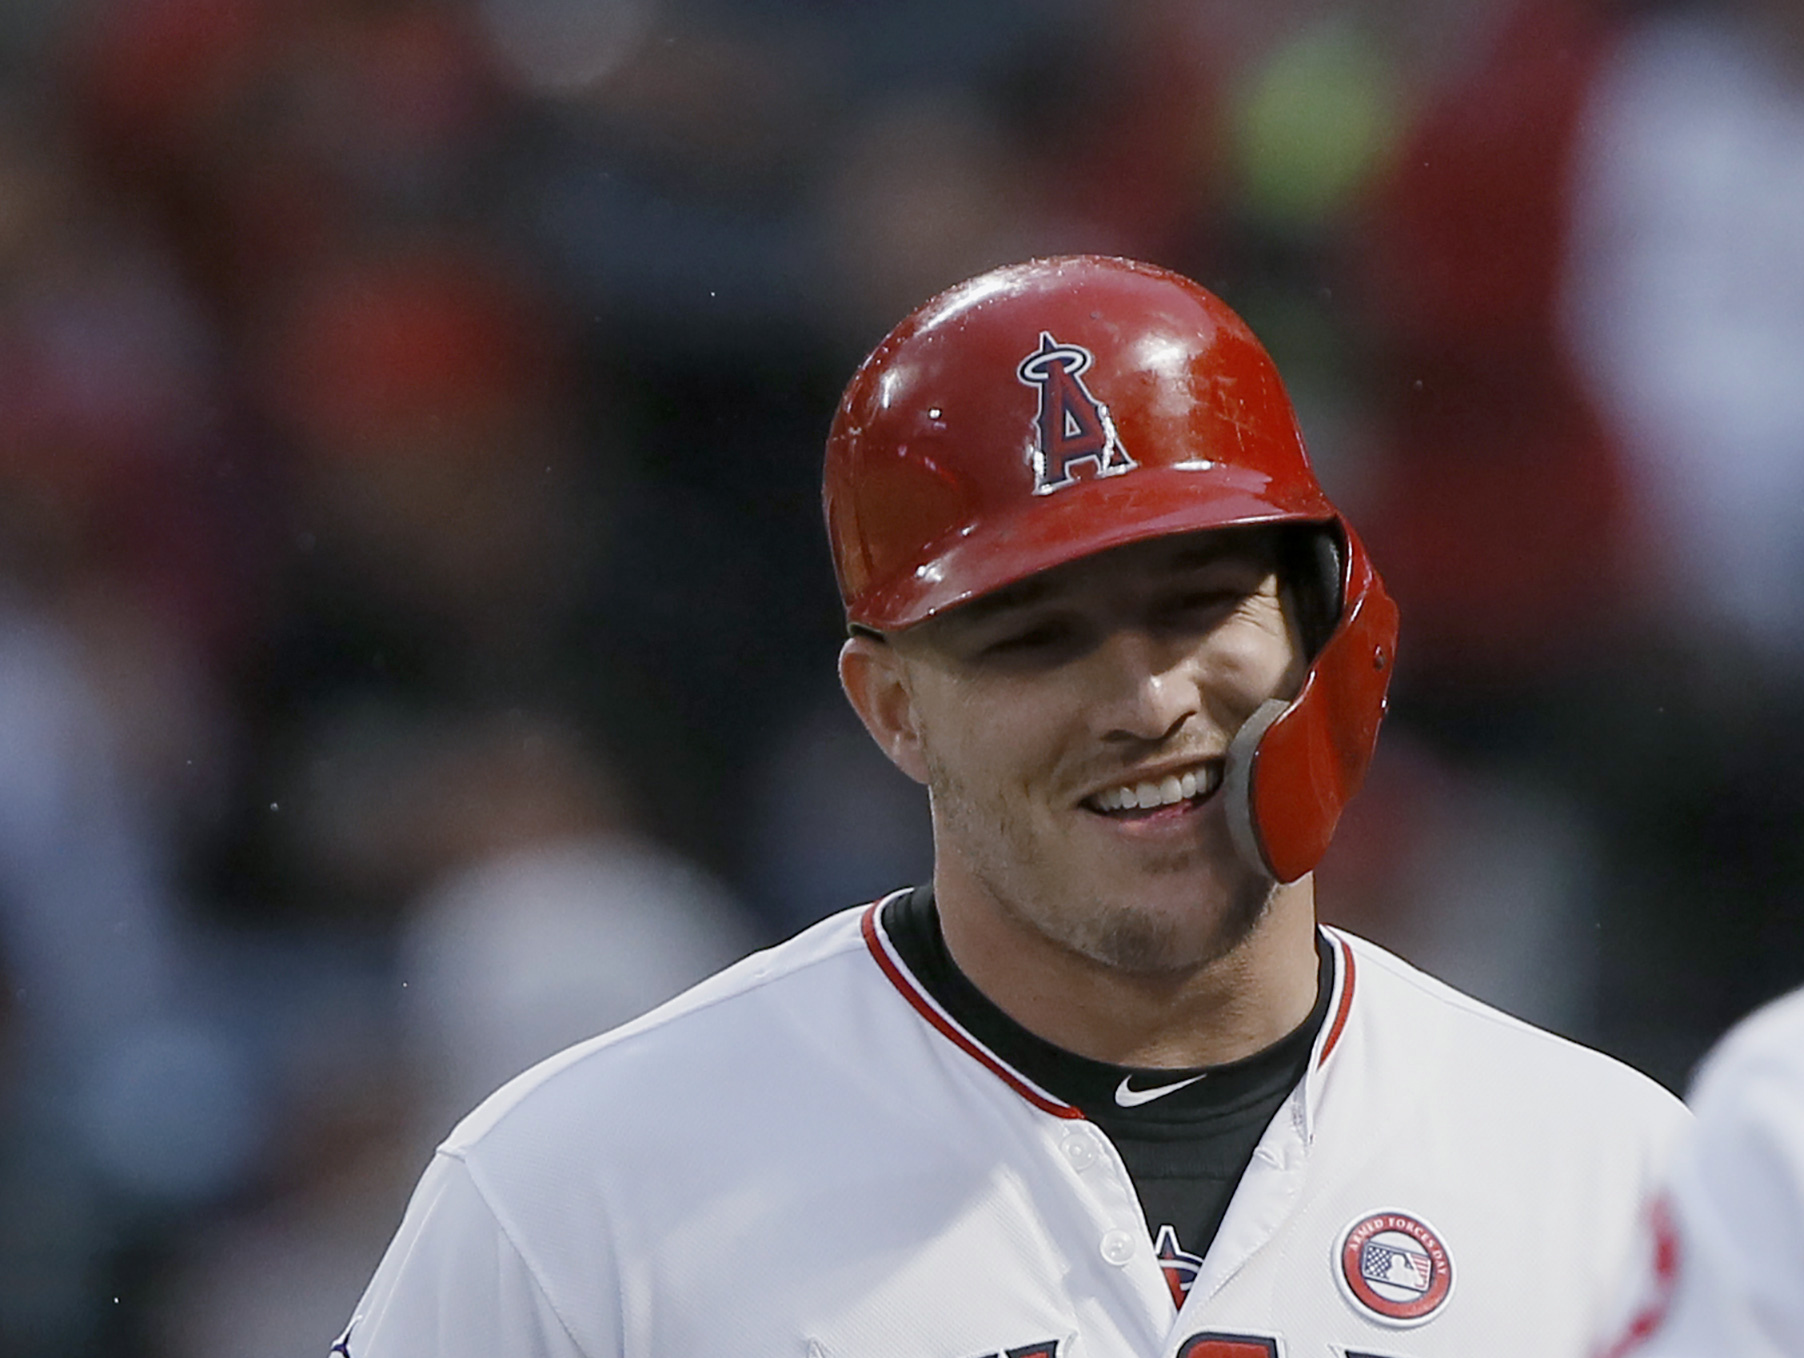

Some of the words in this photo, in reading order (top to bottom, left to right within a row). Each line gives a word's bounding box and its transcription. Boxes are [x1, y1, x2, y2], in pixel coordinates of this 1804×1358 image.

[1017, 331, 1138, 495] A
[1388, 1217, 1434, 1248] FORCES
[1432, 1249, 1447, 1275] DAY
